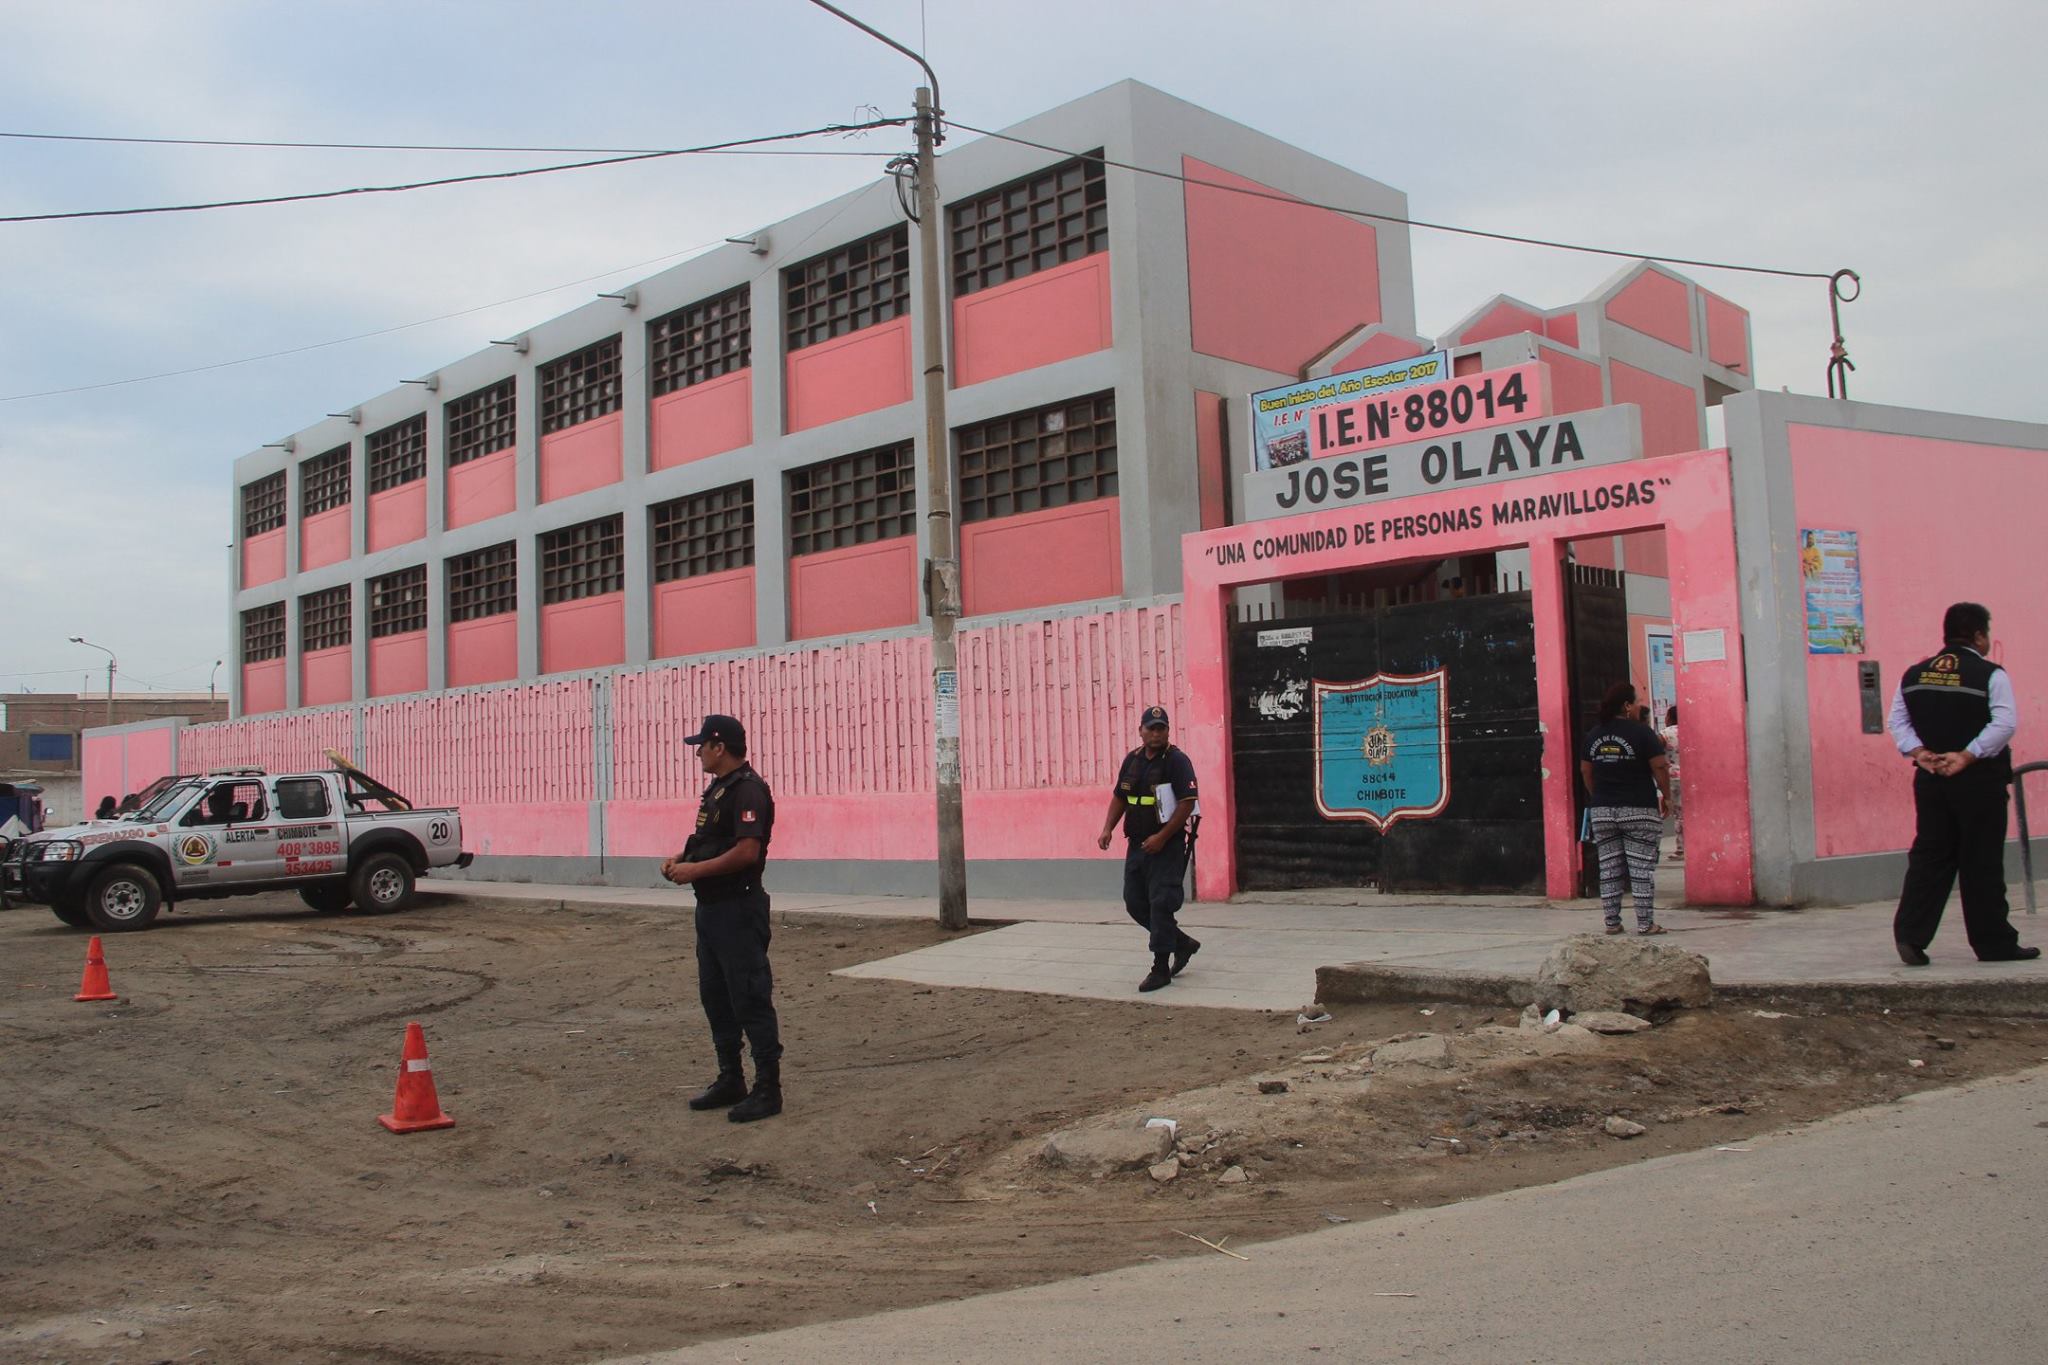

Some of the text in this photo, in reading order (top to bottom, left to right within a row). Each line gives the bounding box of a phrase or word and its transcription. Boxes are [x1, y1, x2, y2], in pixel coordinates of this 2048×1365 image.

[1260, 397, 1288, 412] Buen
[1317, 383, 1337, 399] del
[1339, 378, 1362, 394] Año
[1363, 370, 1409, 389] Escolar
[1410, 360, 1439, 379] 2017
[1276, 421, 1585, 509] JOSE OLAYA
[1252, 526, 1348, 561] COMUNIDAD
[1353, 521, 1376, 545] DE
[1381, 506, 1483, 541] PERSONAS
[1357, 788, 1406, 801] CHIMBOTE
[225, 830, 256, 844] ALERTA
[277, 825, 318, 840] CHIMBOTE
[431, 822, 449, 840] 20
[285, 860, 333, 876] 353425
